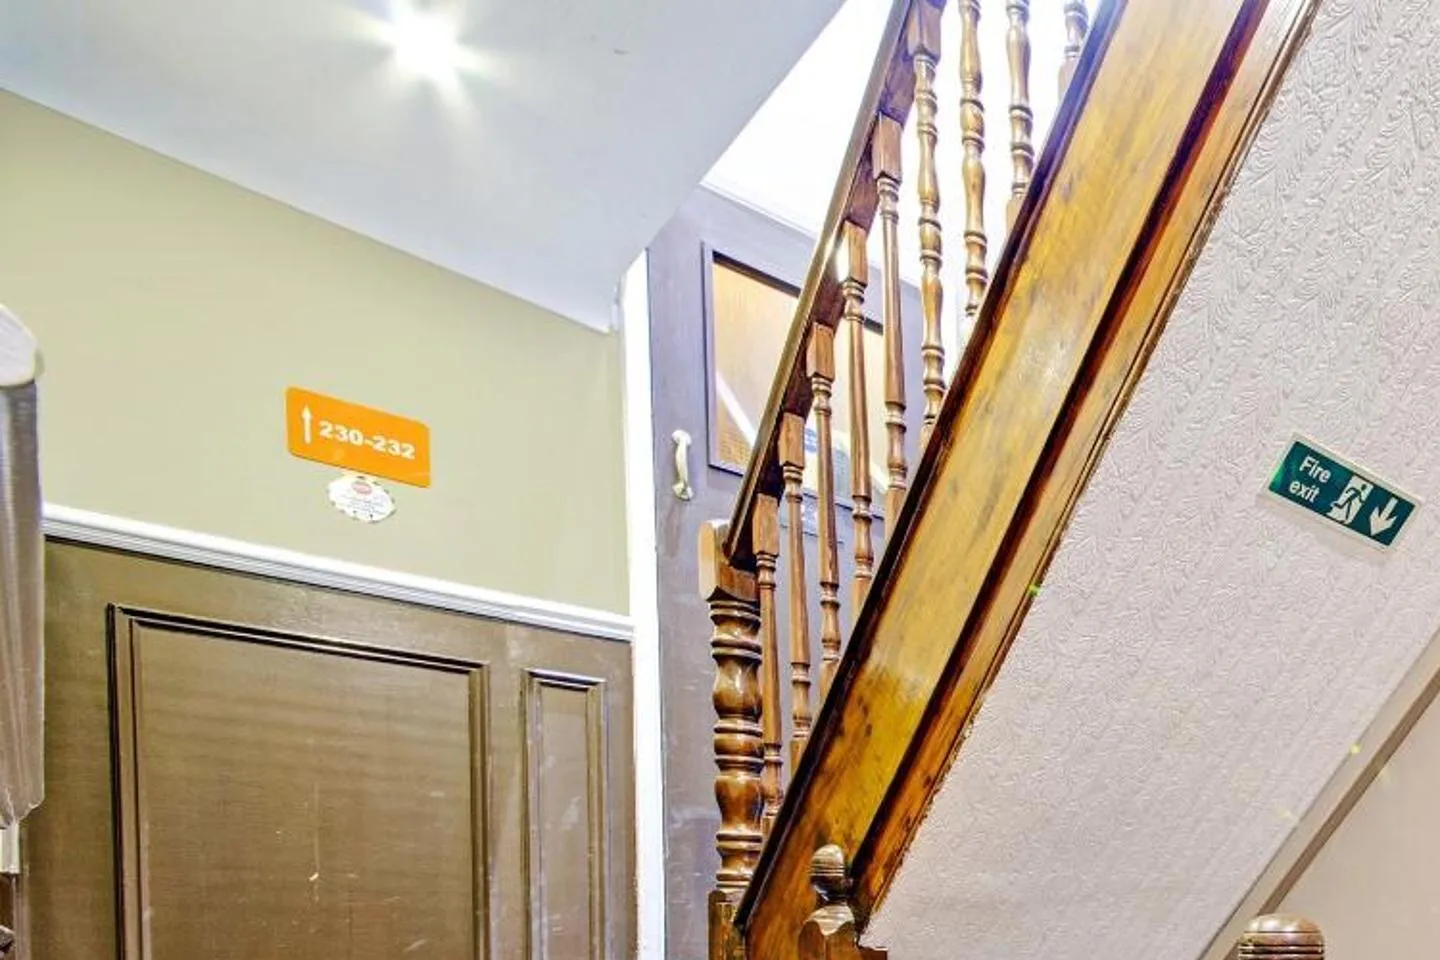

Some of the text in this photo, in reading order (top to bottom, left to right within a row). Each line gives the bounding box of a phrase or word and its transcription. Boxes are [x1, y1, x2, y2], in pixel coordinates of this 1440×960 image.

[318, 419, 416, 461] 230-232
[1298, 455, 1332, 483] Fire
[1288, 479, 1321, 504] exit
